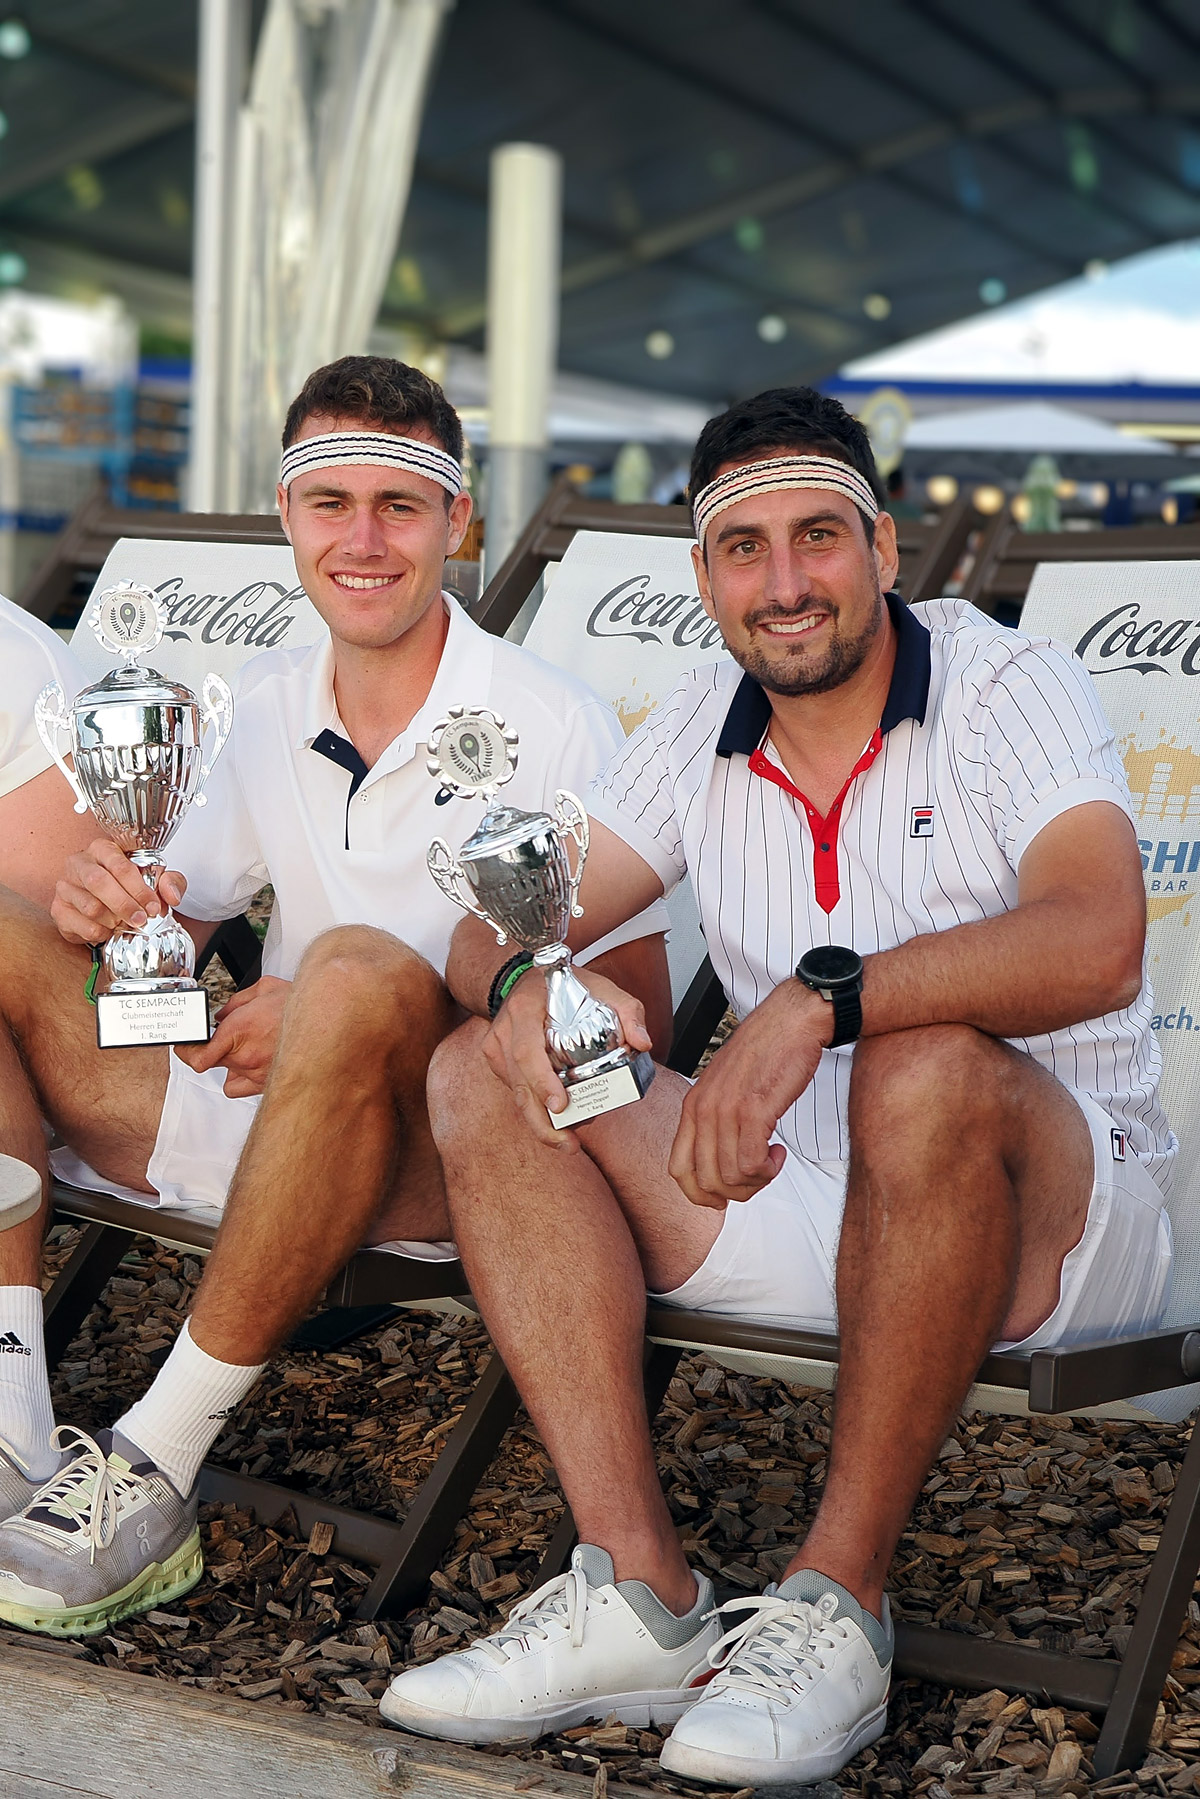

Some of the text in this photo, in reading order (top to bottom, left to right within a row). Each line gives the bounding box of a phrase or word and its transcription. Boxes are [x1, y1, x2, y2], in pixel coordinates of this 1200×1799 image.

[1151, 880, 1188, 891] BAR
[119, 996, 187, 1009] TC SEMPACH
[121, 1010, 184, 1020] Clubmeisterschaft
[129, 1021, 178, 1031] Herren Einzel
[149, 1032, 167, 1041] Rang
